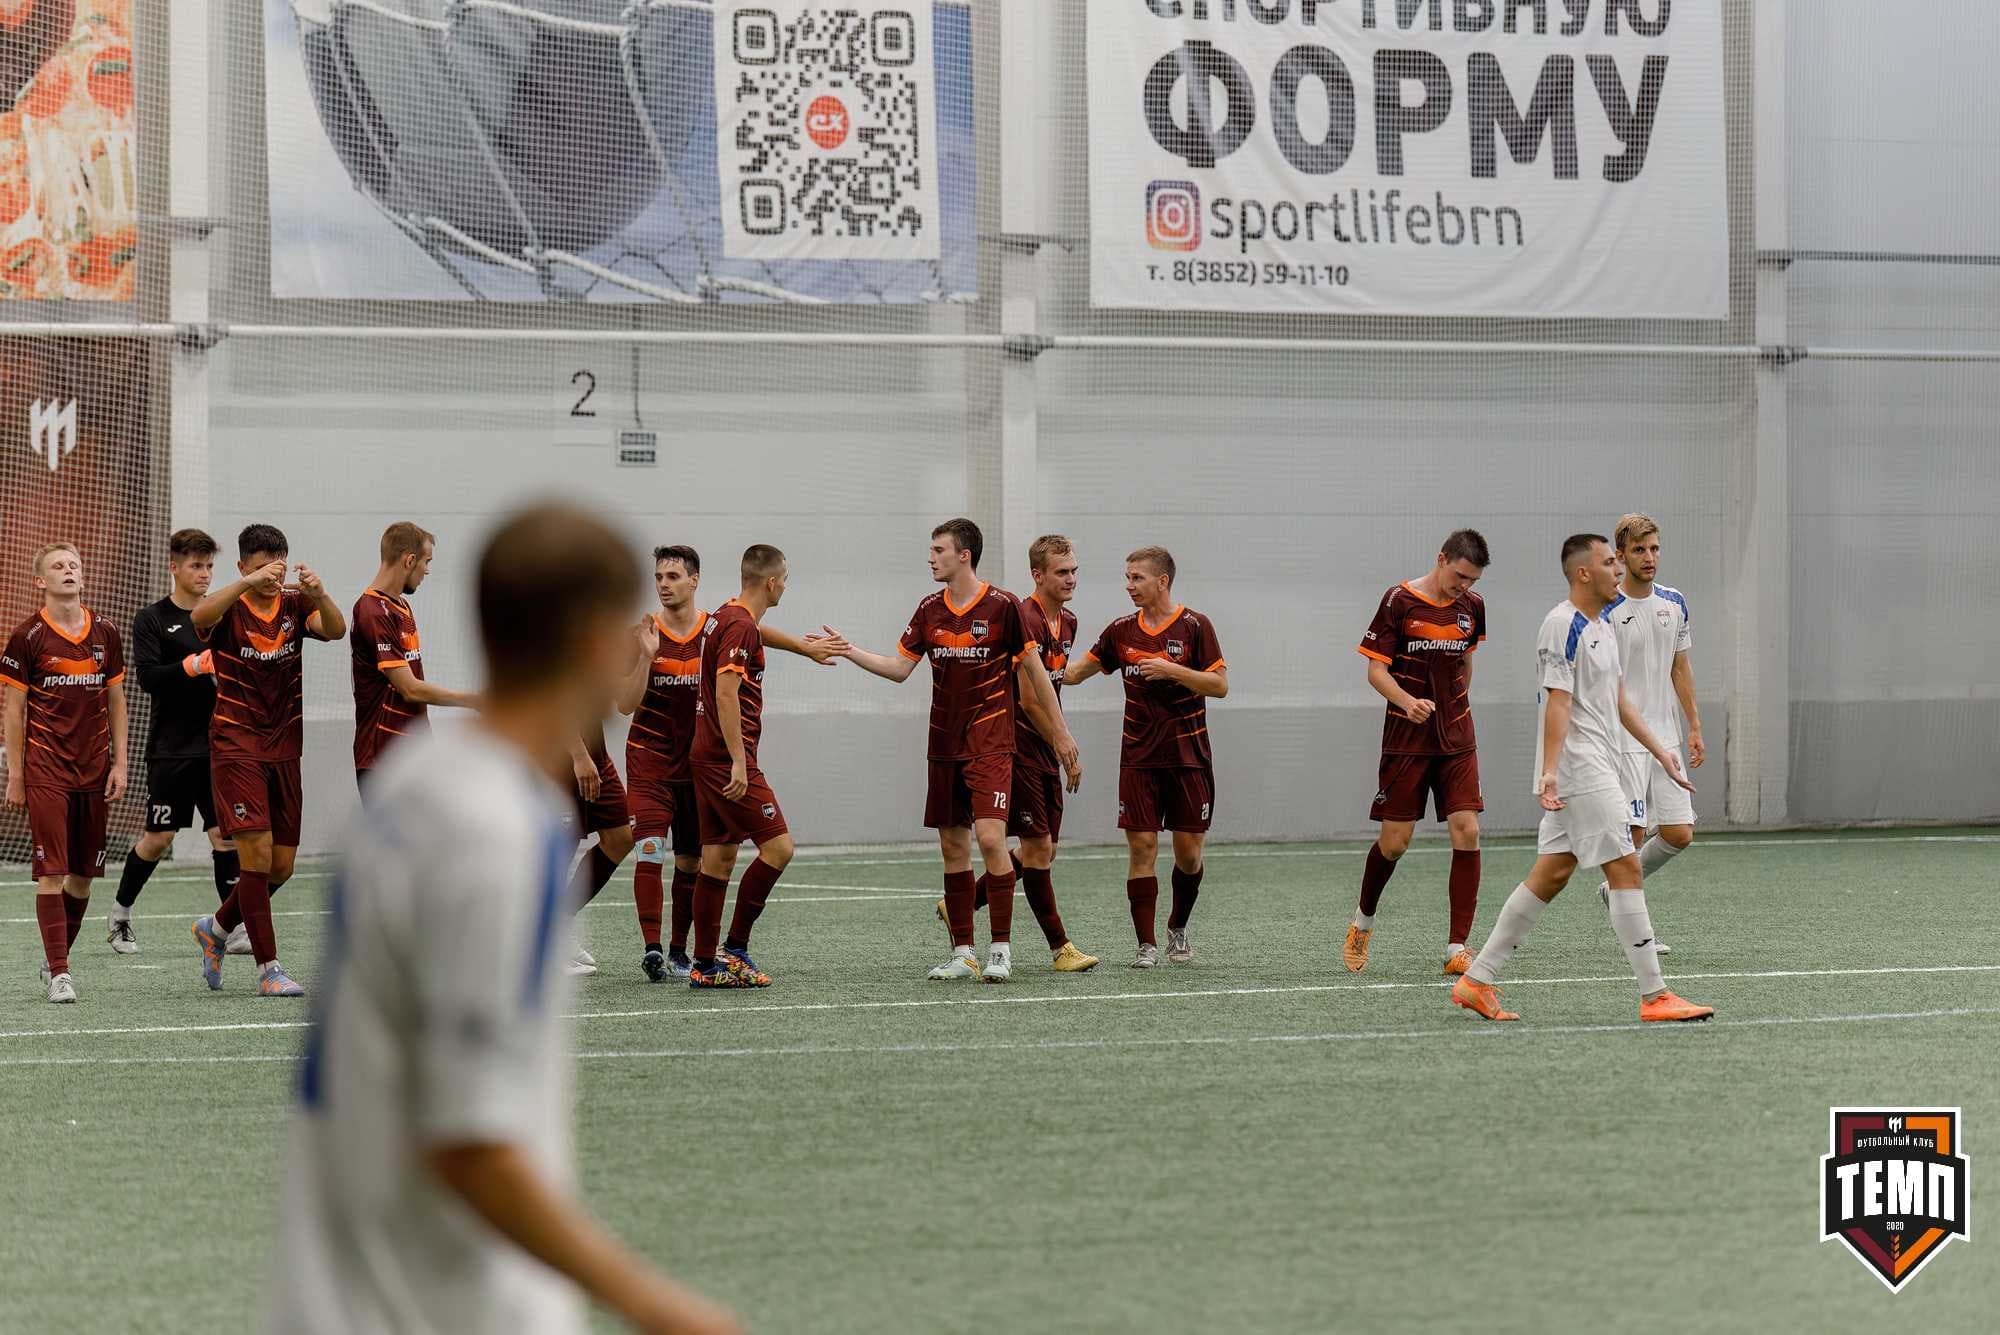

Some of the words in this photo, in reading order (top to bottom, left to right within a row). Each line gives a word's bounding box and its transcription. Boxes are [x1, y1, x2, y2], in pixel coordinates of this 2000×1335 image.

[1143, 40, 1670, 182] ФОРМУ
[1210, 189, 1524, 254] sportlifebrn
[1174, 260, 1256, 287] 8(3852)
[1263, 263, 1350, 286] 59-11-10
[571, 370, 596, 417] 2
[1364, 630, 1377, 640] СБ
[1407, 640, 1469, 653] ПРОДИНВЕС
[2, 655, 20, 670] ПСБ
[994, 791, 1006, 809] 72
[1631, 799, 1645, 818] 19
[152, 804, 171, 825] 72
[95, 850, 106, 866] 17
